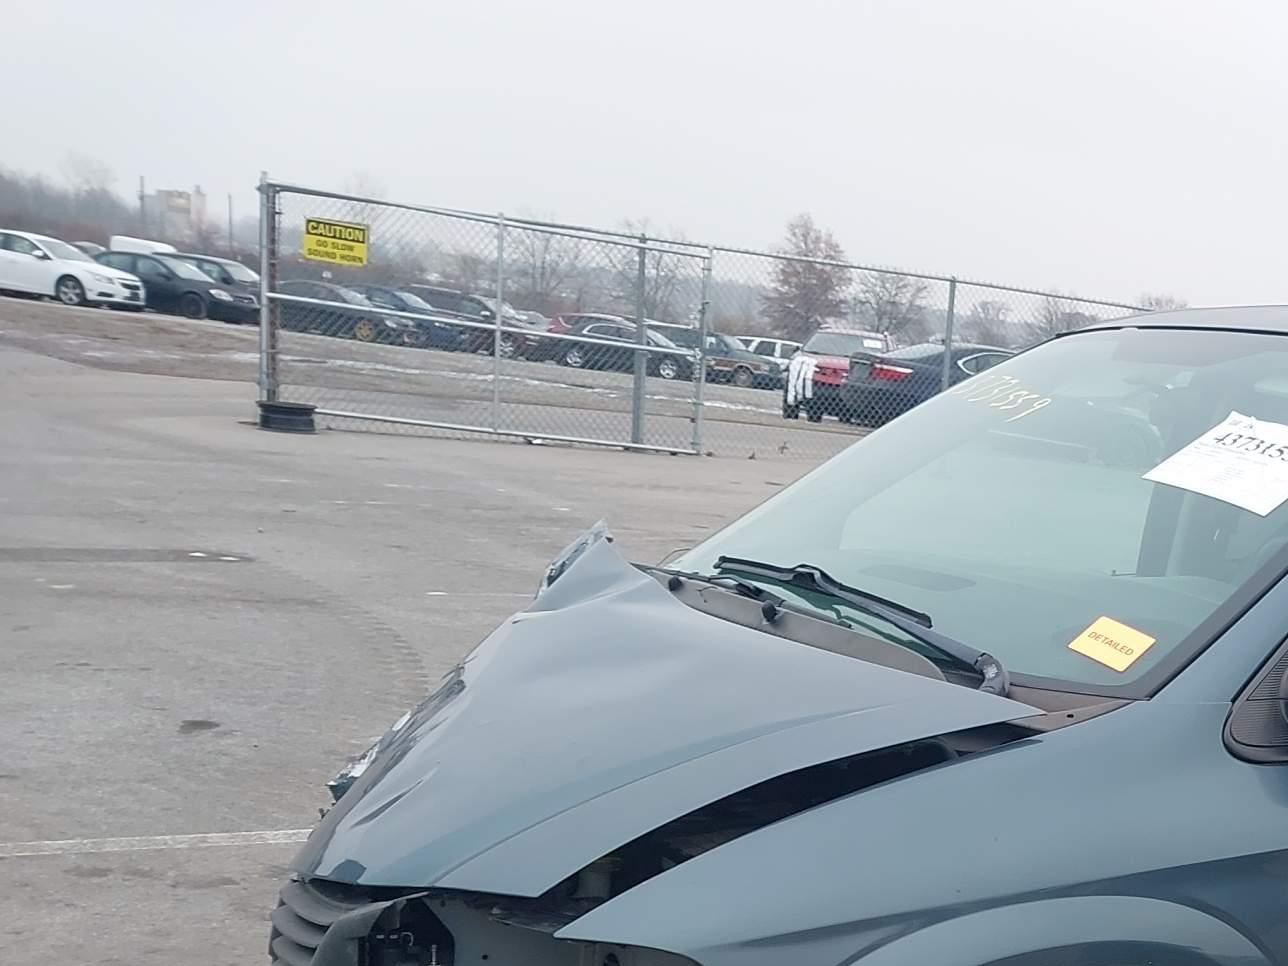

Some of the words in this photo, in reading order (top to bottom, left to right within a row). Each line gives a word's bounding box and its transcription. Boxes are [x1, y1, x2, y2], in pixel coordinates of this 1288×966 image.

[308, 222, 363, 242] CAUTION
[315, 239, 328, 248] GO
[331, 242, 355, 252] SLOW
[307, 248, 337, 259] SOUND
[339, 254, 363, 264] HORN
[1087, 631, 1135, 656] DETAILED
